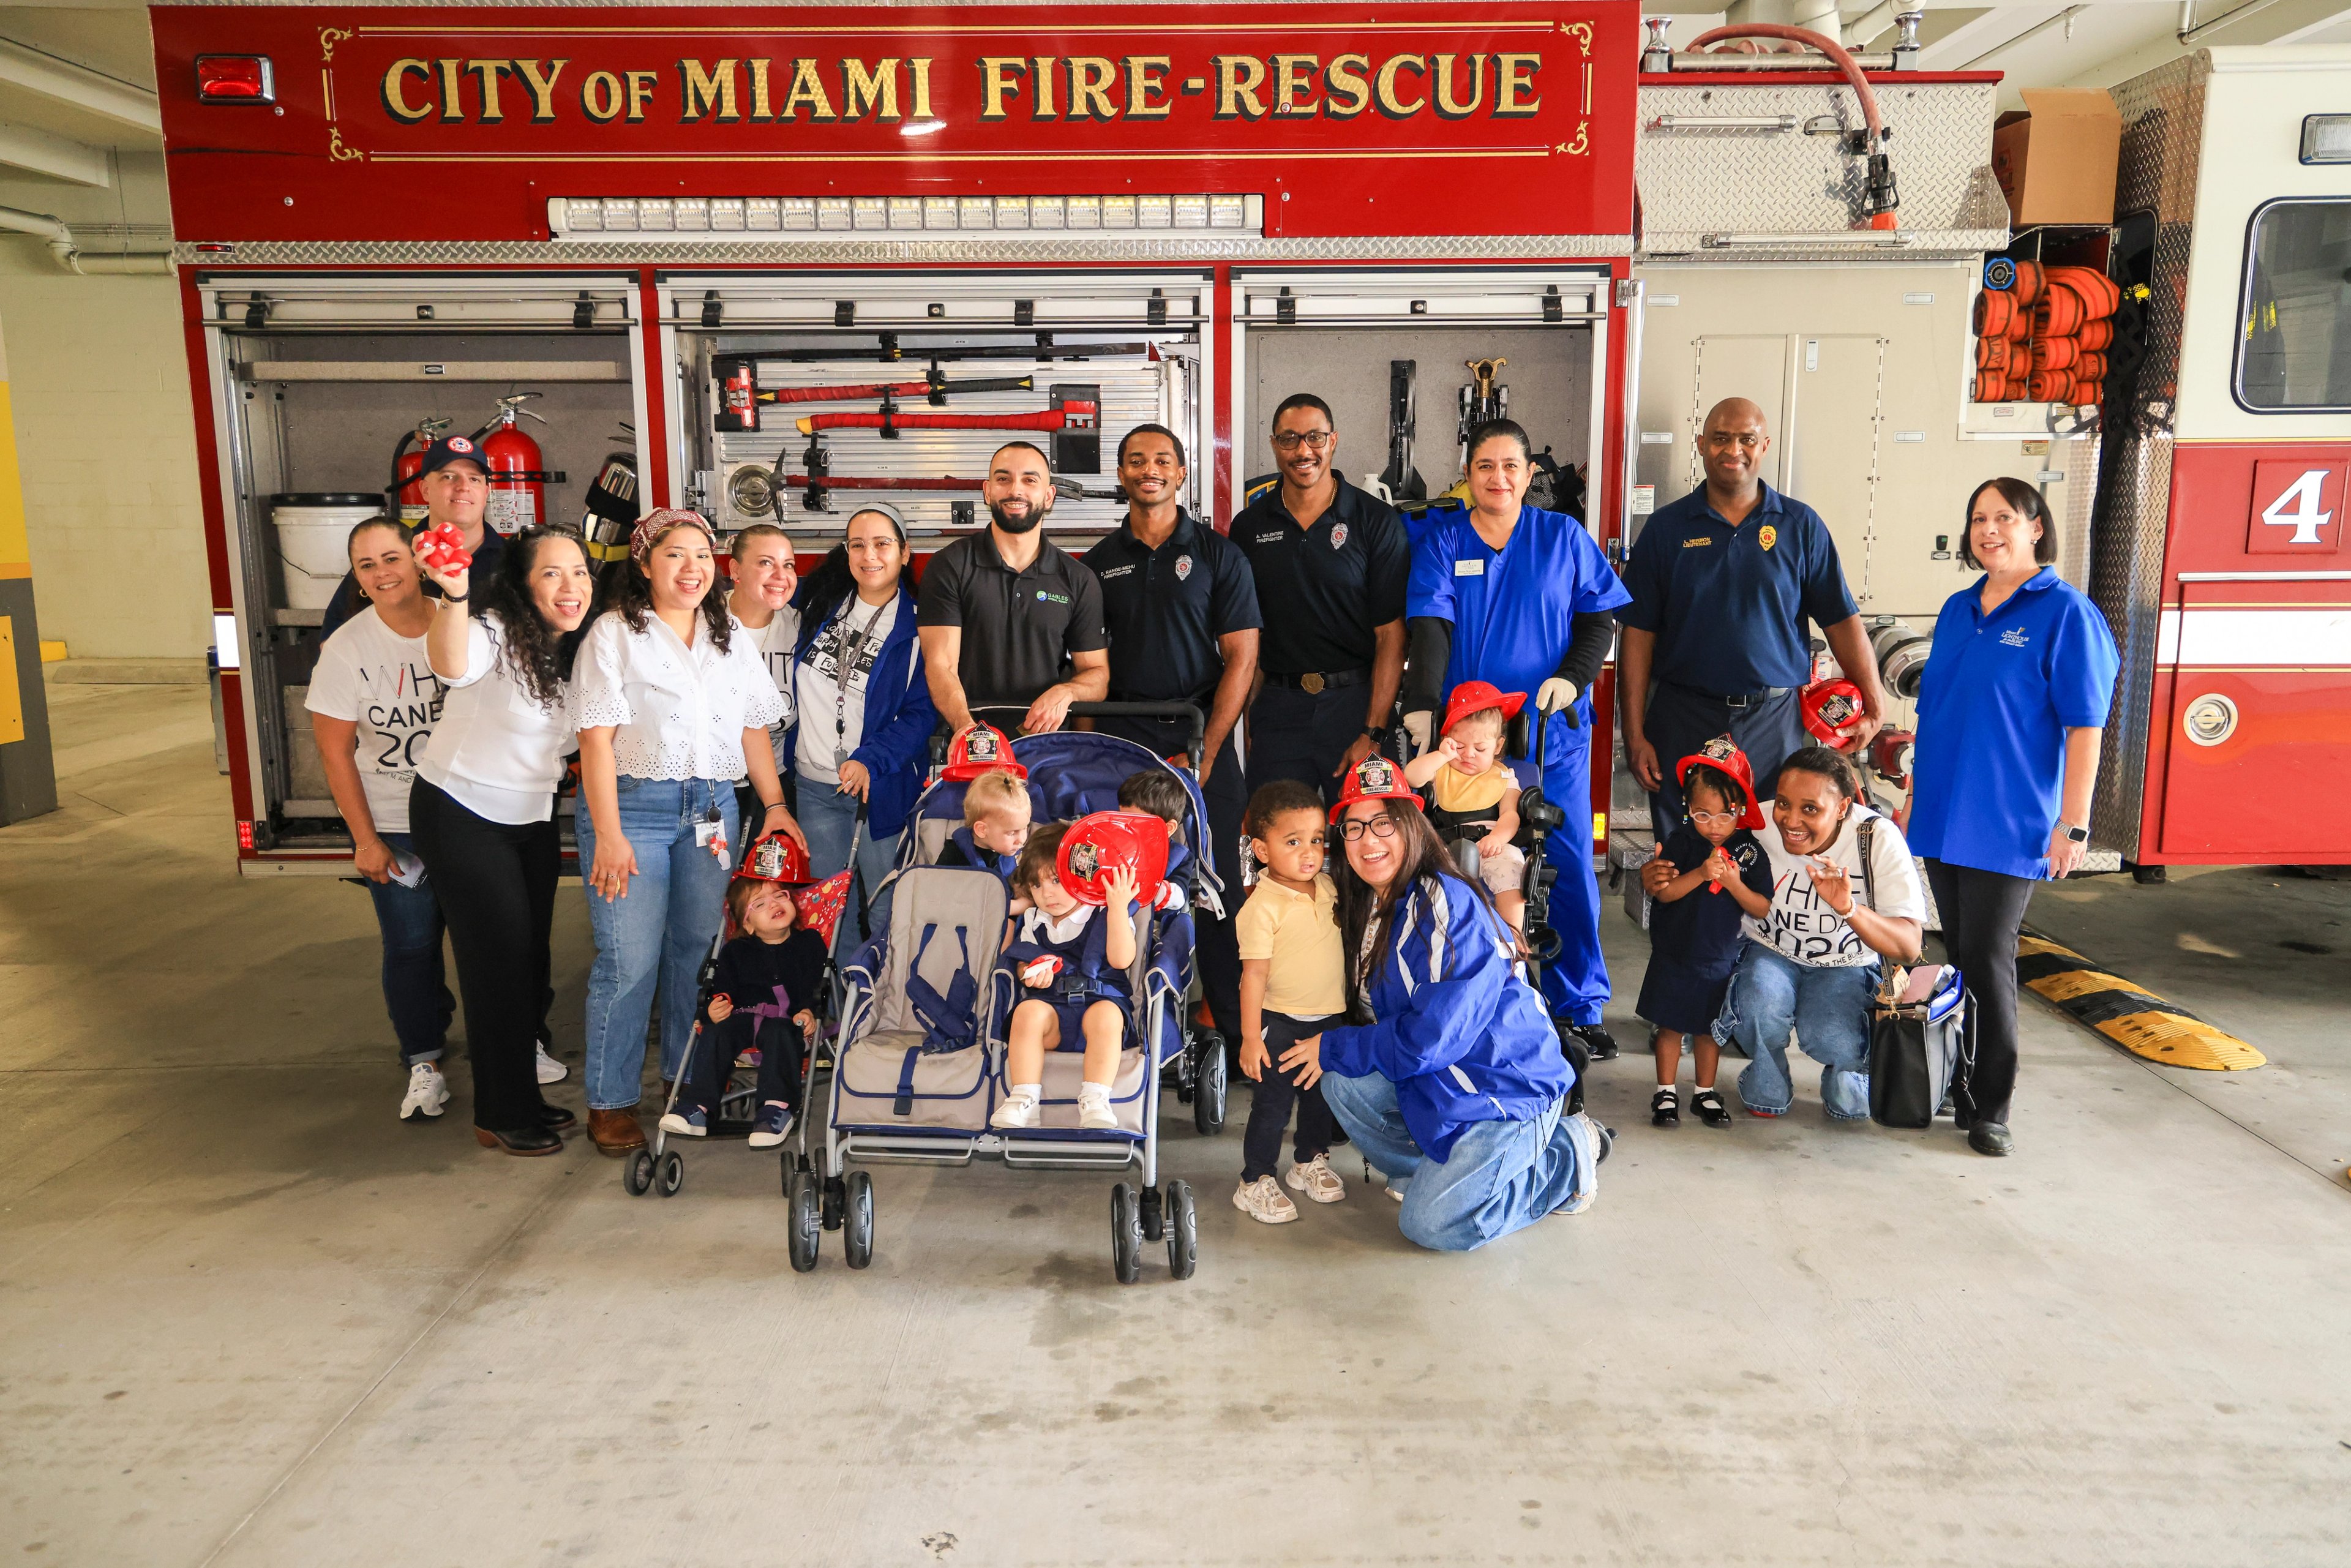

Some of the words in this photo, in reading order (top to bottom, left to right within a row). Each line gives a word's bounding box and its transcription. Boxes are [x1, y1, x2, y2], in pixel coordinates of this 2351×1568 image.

[380, 58, 571, 124] CITY
[580, 70, 658, 124] OF
[675, 58, 935, 124] MIAMI
[2261, 470, 2333, 543] 4
[1256, 535, 1283, 544] FIREFIGHTER
[1103, 569, 1133, 580] FIREFIGHTER
[1106, 564, 1136, 575] RANGE-MEHU
[1048, 593, 1068, 601] GABLES
[1837, 698, 1850, 711] MIAMI
[368, 700, 443, 729] CANE
[1734, 842, 1747, 853] MIAMI
[1748, 842, 1758, 866] LIGHTHOUSE
[1832, 956, 1847, 967] THE
